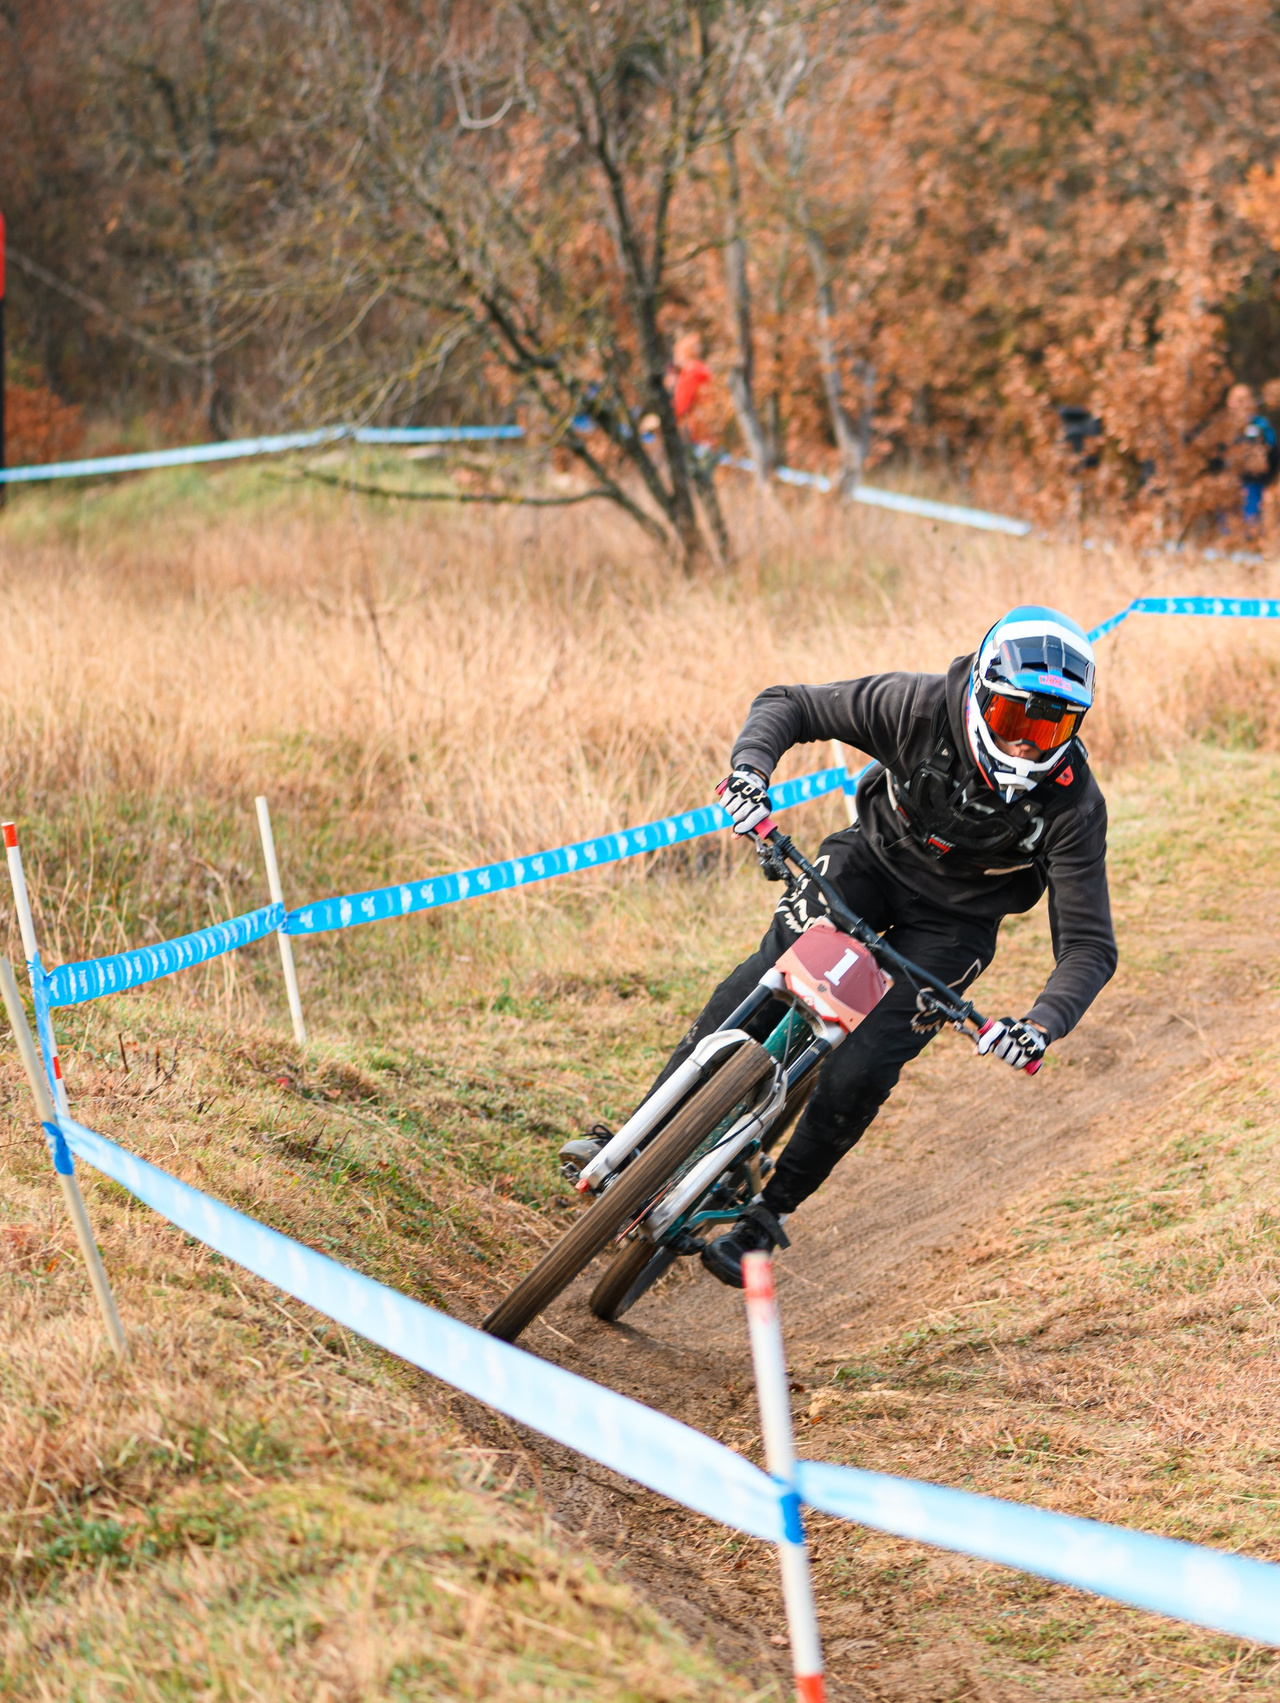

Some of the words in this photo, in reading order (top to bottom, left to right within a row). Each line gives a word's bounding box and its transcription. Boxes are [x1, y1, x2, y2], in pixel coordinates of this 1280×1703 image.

[731, 778, 767, 803] FOX
[824, 948, 860, 987] 1
[1010, 1022, 1039, 1055] FOX
